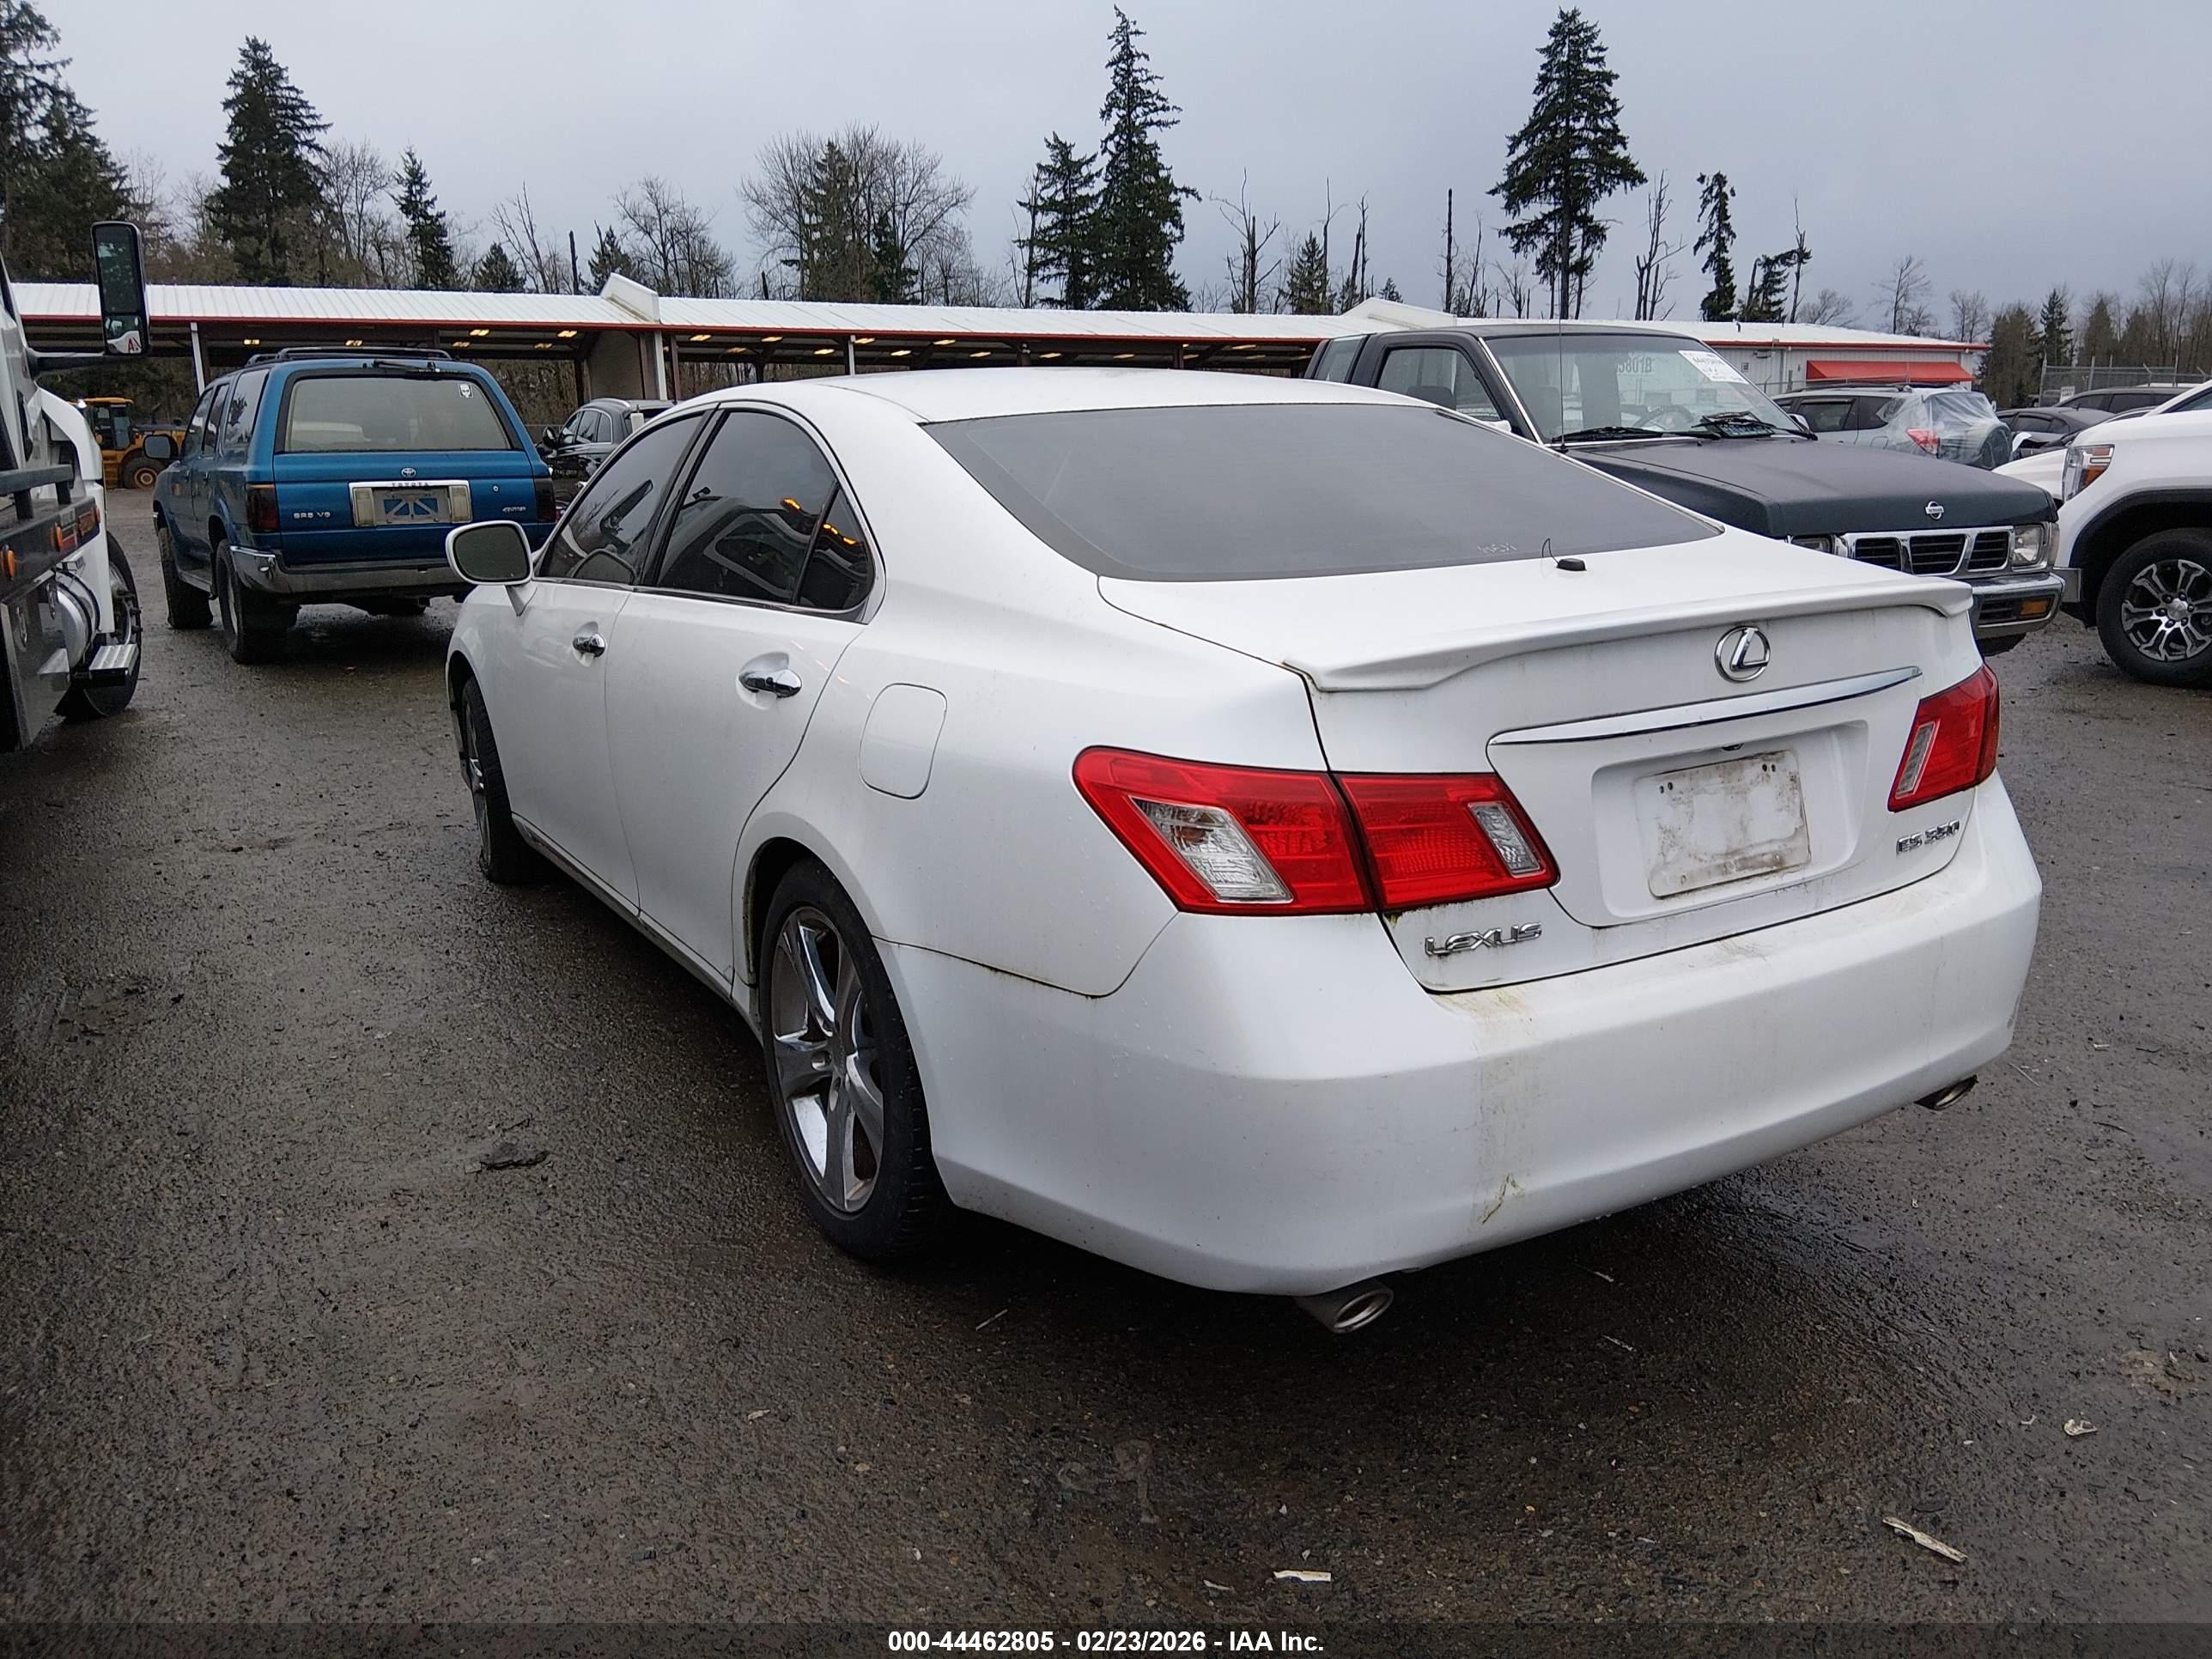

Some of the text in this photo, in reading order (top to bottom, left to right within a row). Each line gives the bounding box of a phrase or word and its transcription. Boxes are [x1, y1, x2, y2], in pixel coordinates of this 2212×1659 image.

[1896, 819, 1960, 854] ES 350
[1425, 921, 1542, 956] LEXUS
